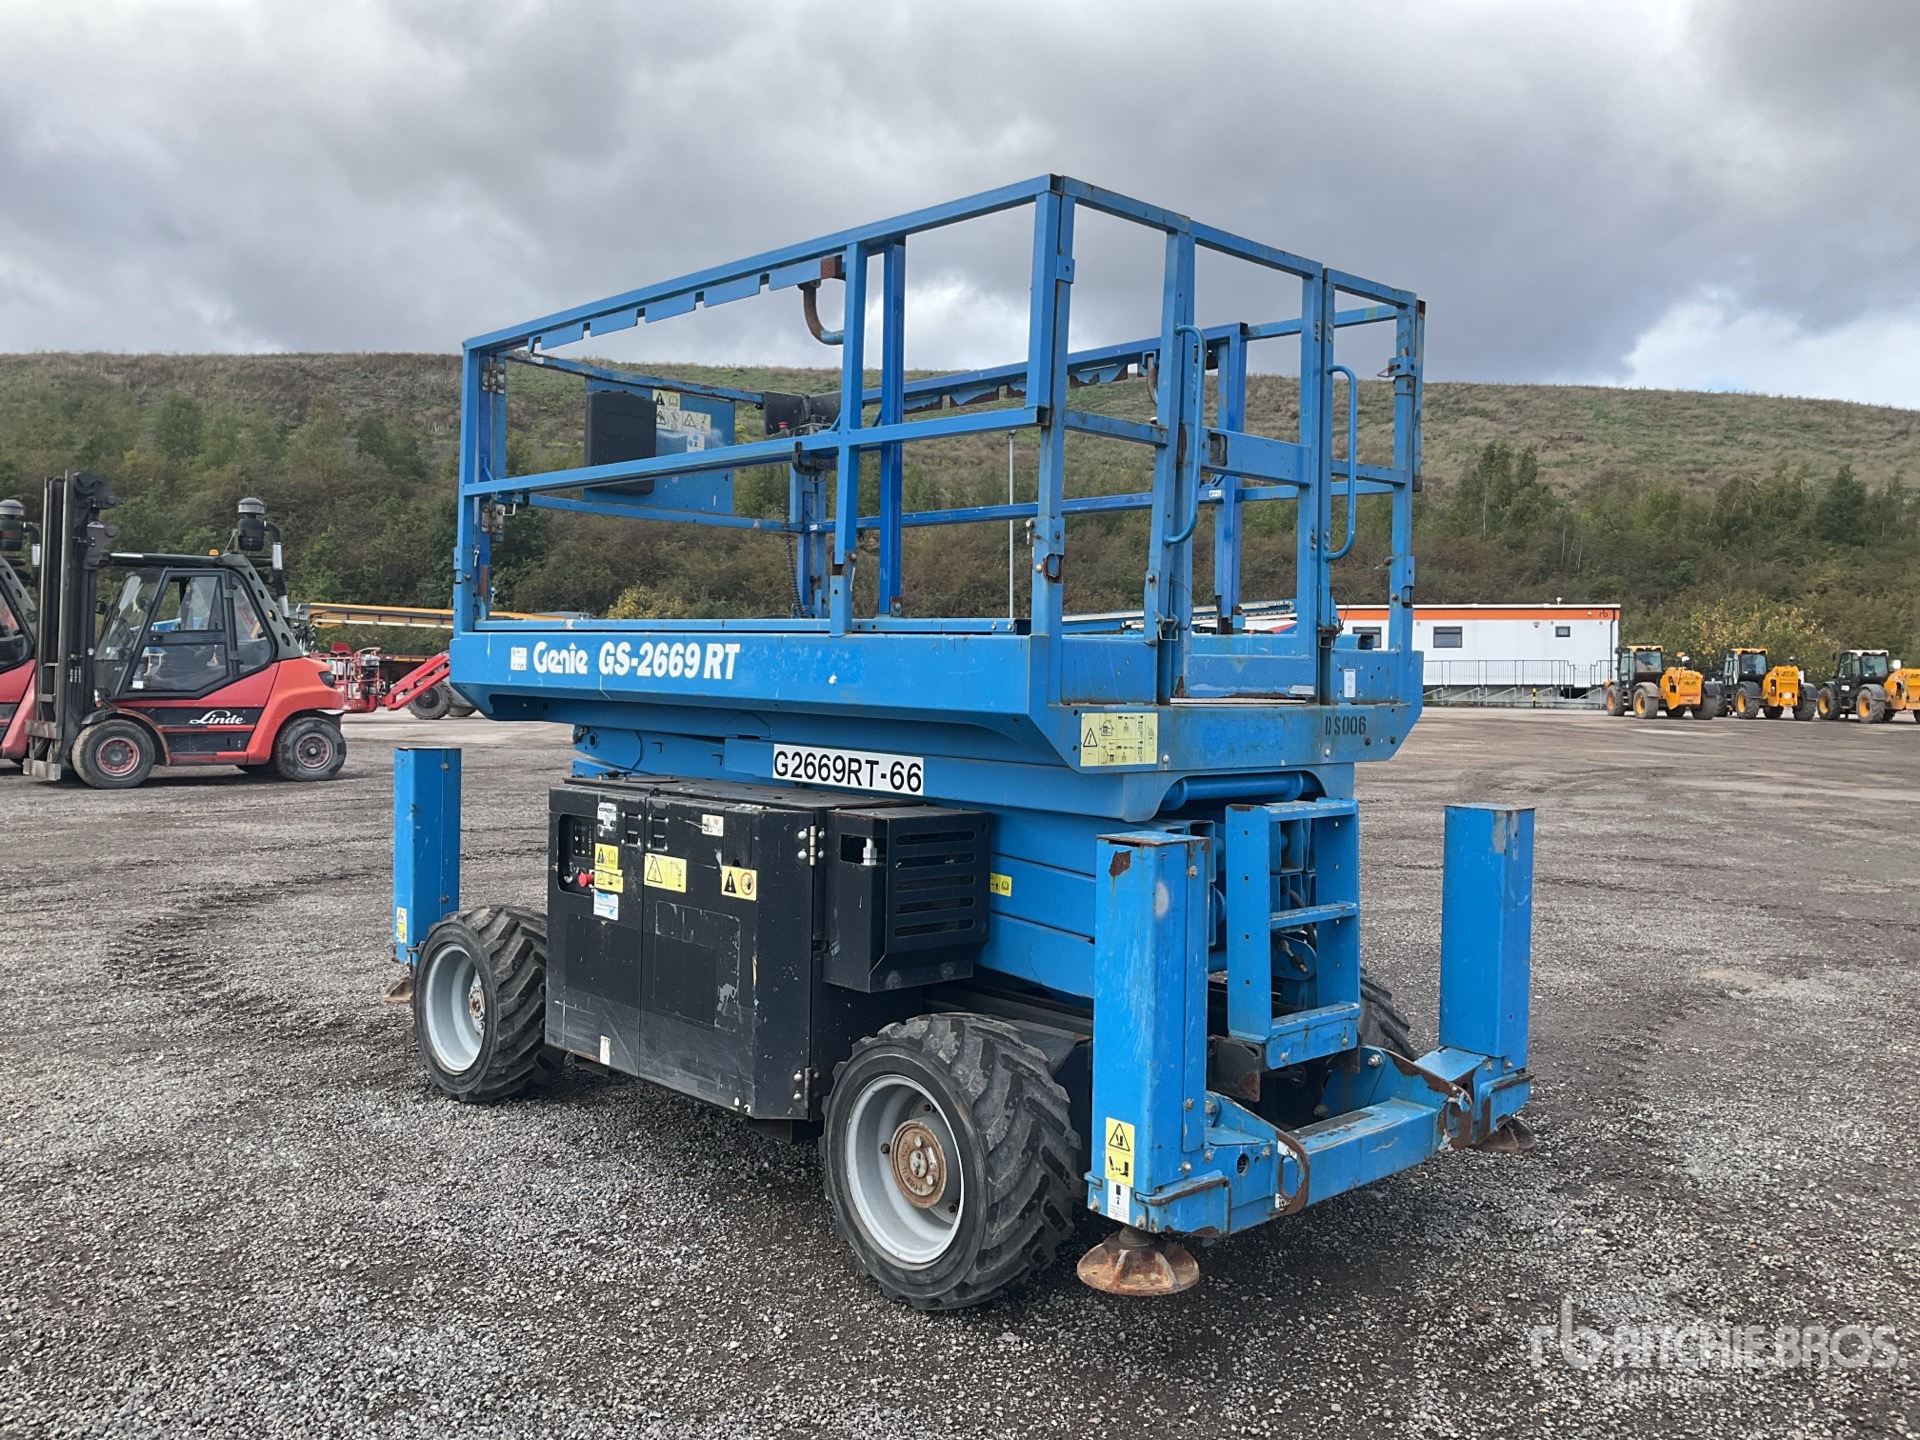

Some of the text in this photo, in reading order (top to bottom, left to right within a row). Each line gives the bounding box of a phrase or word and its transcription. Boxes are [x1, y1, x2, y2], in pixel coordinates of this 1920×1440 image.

[533, 641, 588, 674] Genie
[599, 641, 700, 679] GS-2669
[703, 643, 740, 680] RT
[189, 709, 244, 724] Linde
[774, 750, 922, 793] G2669RT-66
